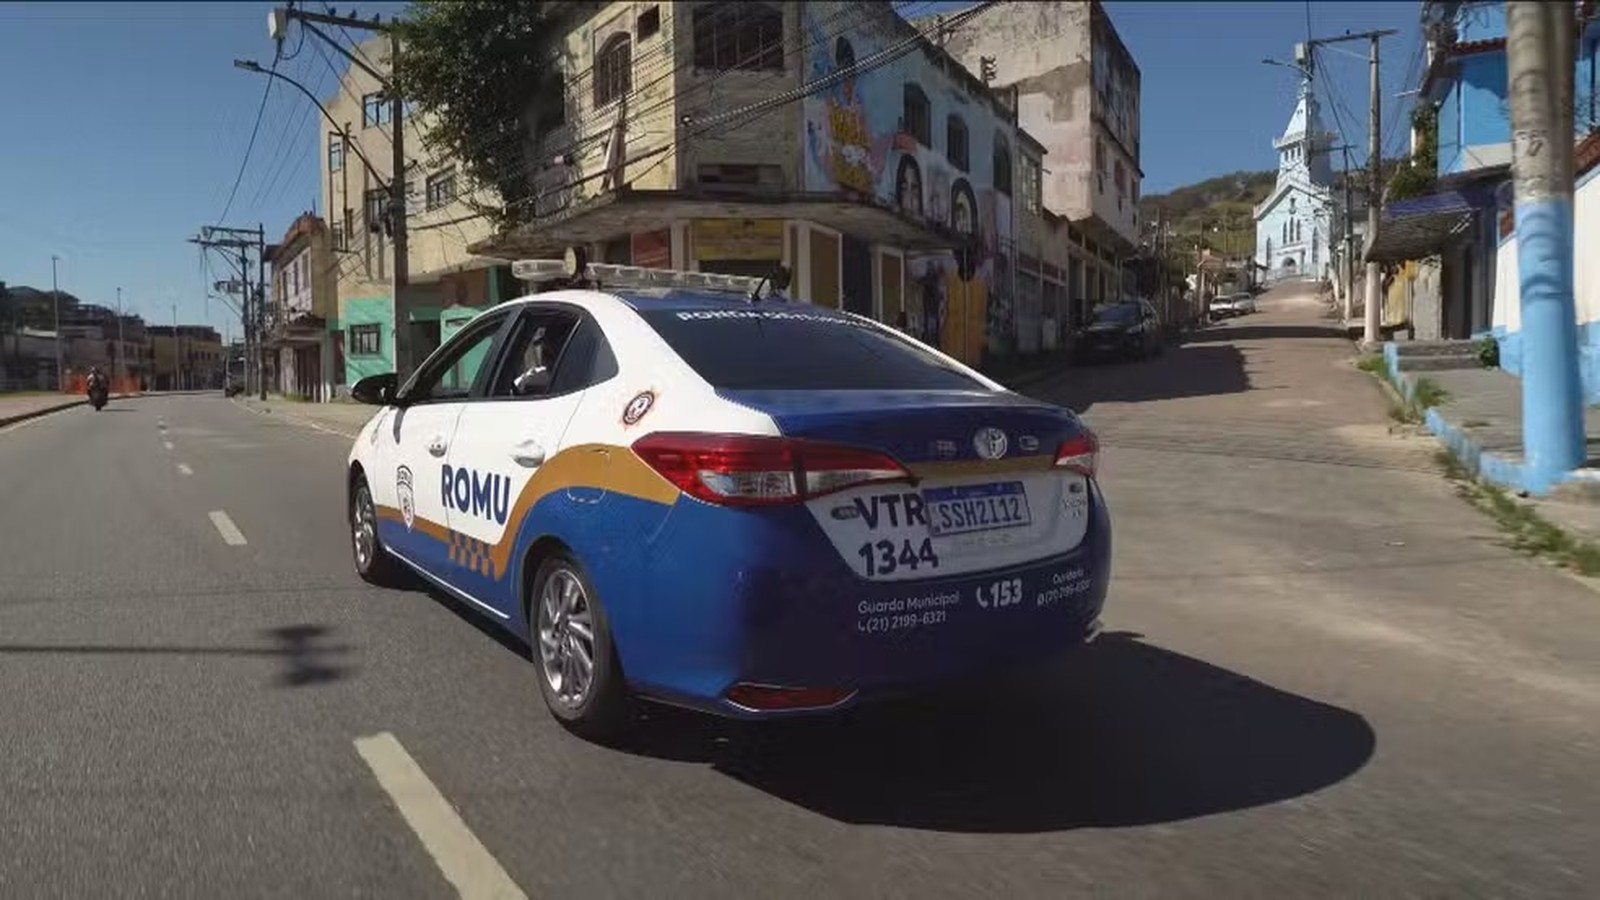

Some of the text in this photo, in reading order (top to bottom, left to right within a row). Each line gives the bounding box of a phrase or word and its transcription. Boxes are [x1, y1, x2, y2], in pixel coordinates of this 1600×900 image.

[442, 464, 511, 525] ROMU
[853, 493, 927, 529] VTR
[938, 497, 1021, 528] SSH2I12
[858, 537, 938, 577] 1344
[858, 590, 960, 614] Guarda Municipal
[990, 578, 1022, 608] 153
[866, 610, 946, 633] (21) 2199-6321
